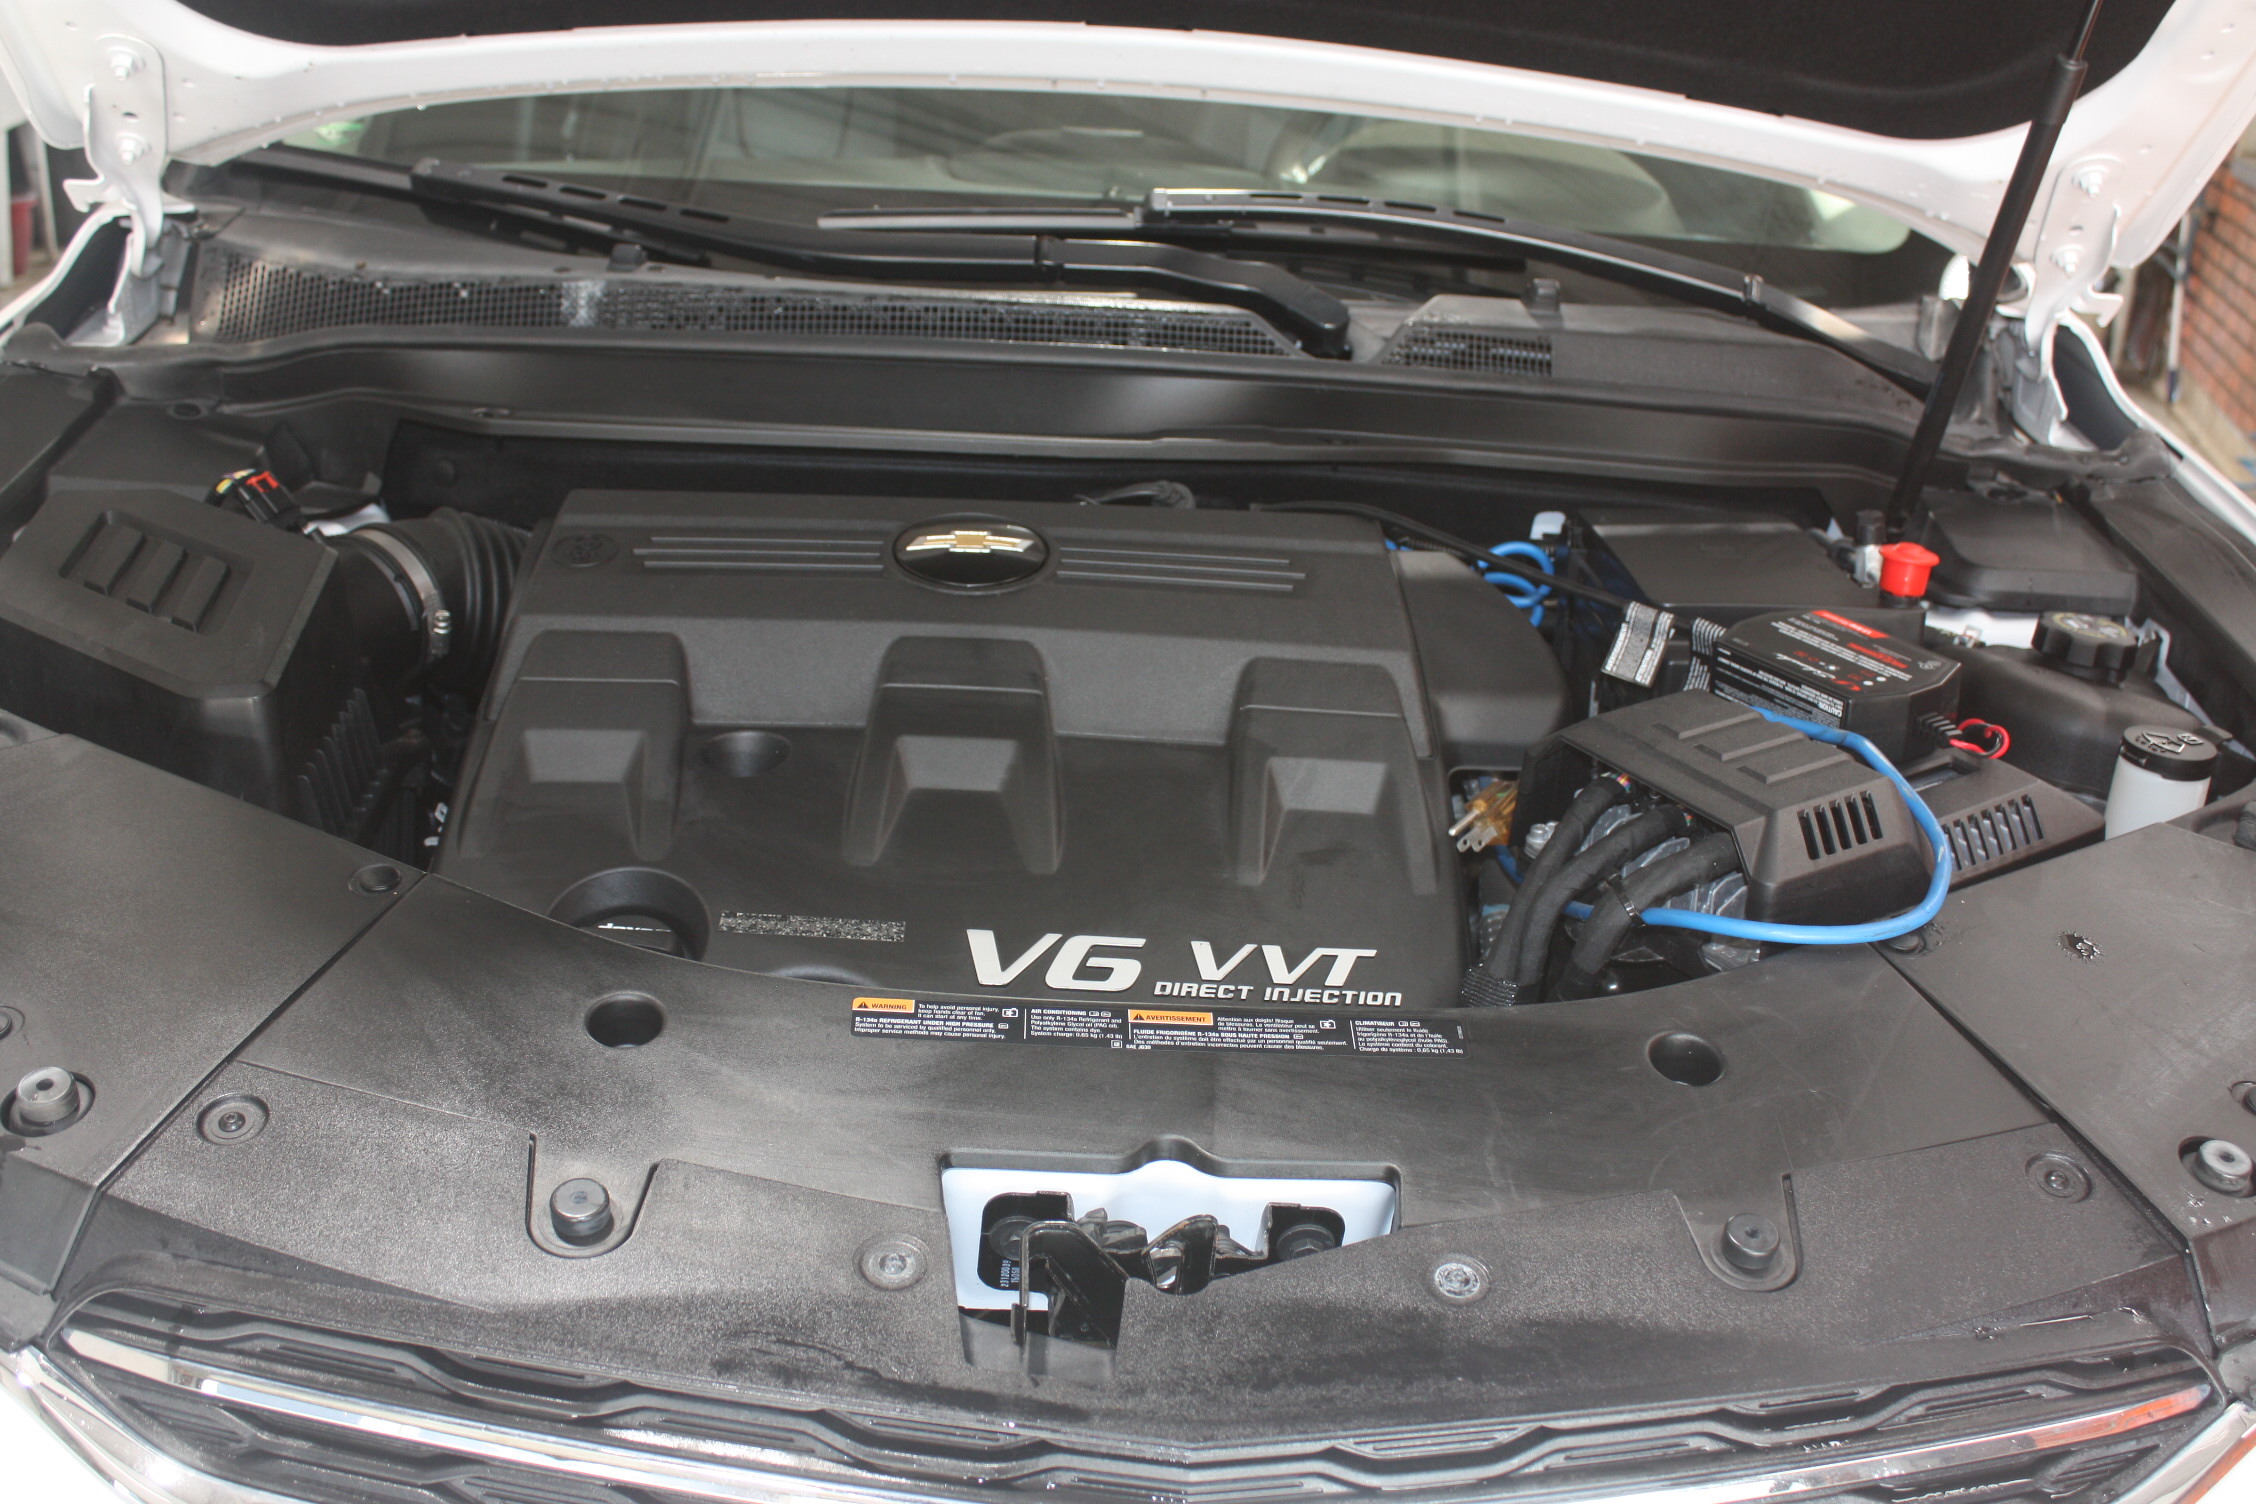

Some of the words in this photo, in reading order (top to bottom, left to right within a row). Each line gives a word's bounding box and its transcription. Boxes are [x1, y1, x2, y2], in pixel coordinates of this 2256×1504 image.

[966, 928, 1147, 992] V6
[1190, 940, 1378, 986] VVT
[1153, 980, 1254, 1000] DIRECT
[1263, 986, 1402, 1006] INJECTION
